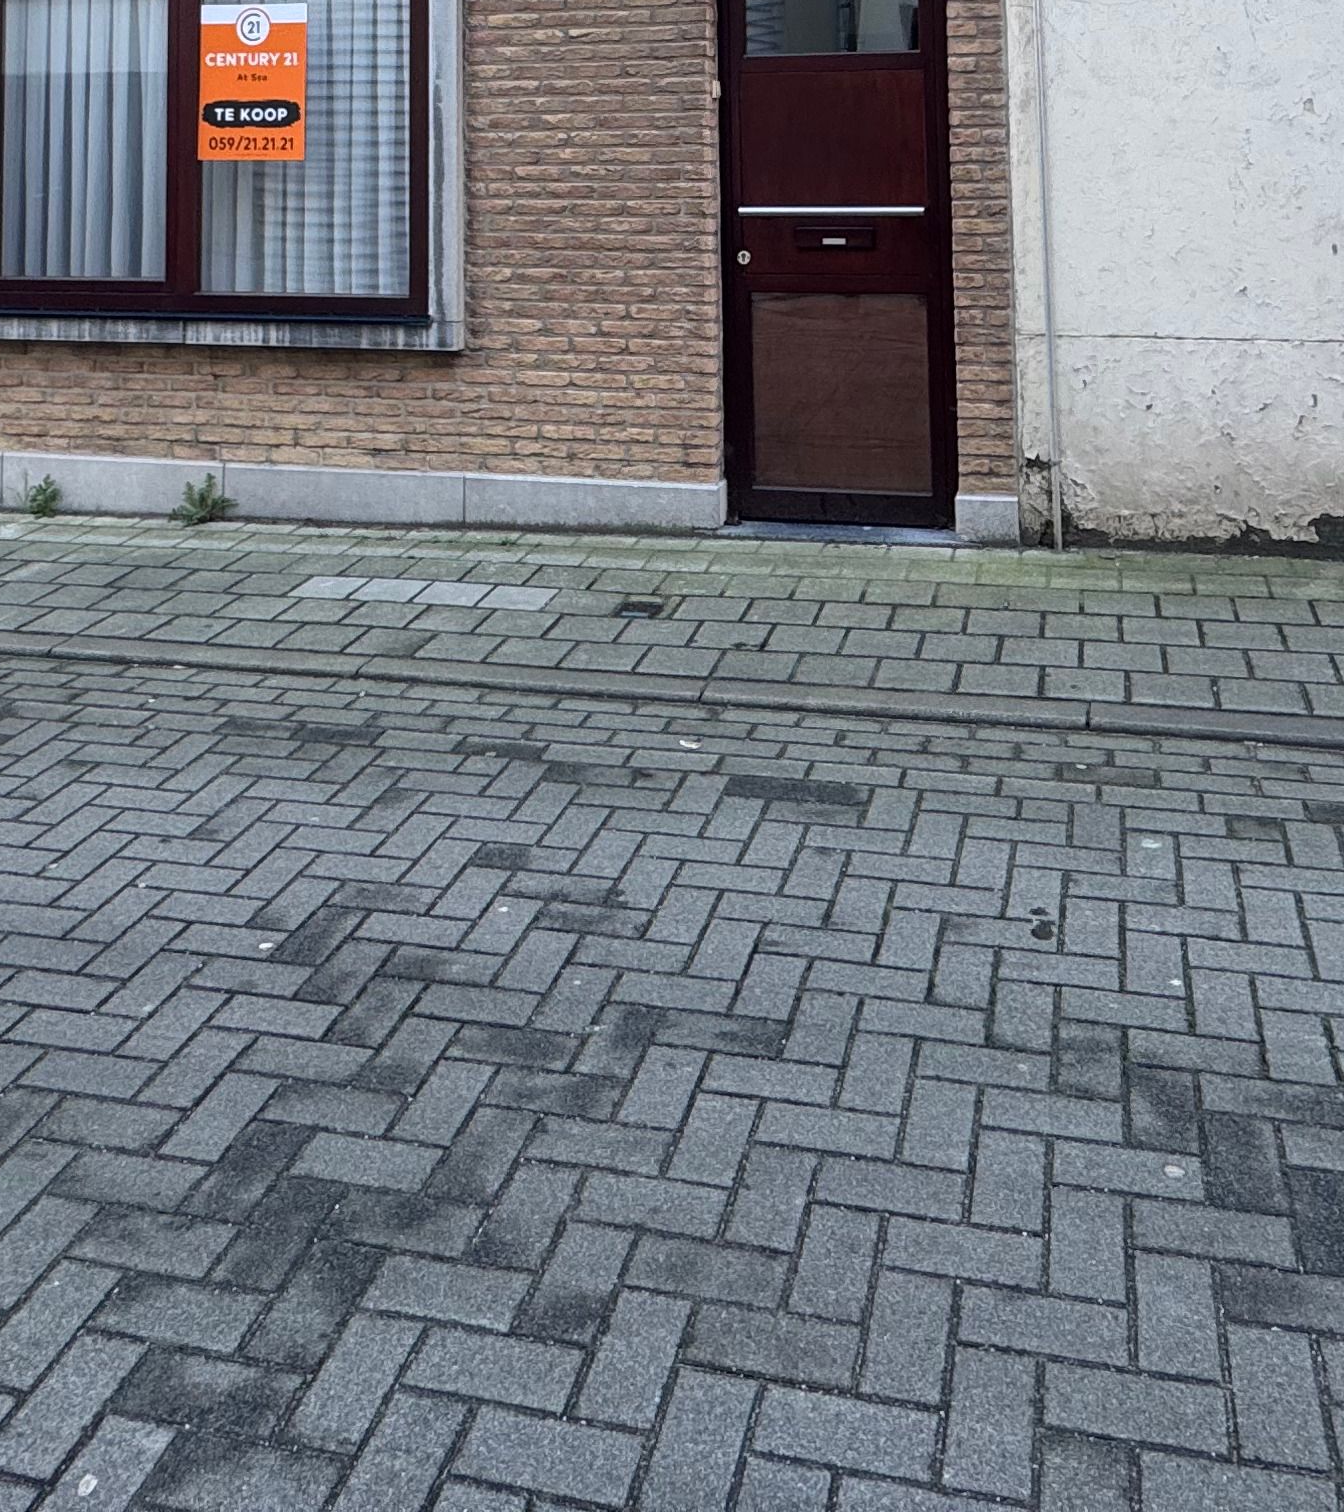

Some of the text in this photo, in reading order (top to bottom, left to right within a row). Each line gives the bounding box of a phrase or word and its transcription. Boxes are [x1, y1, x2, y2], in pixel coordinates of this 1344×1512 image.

[205, 51, 299, 67] CENTURY 21
[237, 73, 268, 81] At Sea
[214, 108, 288, 122] TE KOOP
[208, 135, 294, 151] 059/21.21.21
